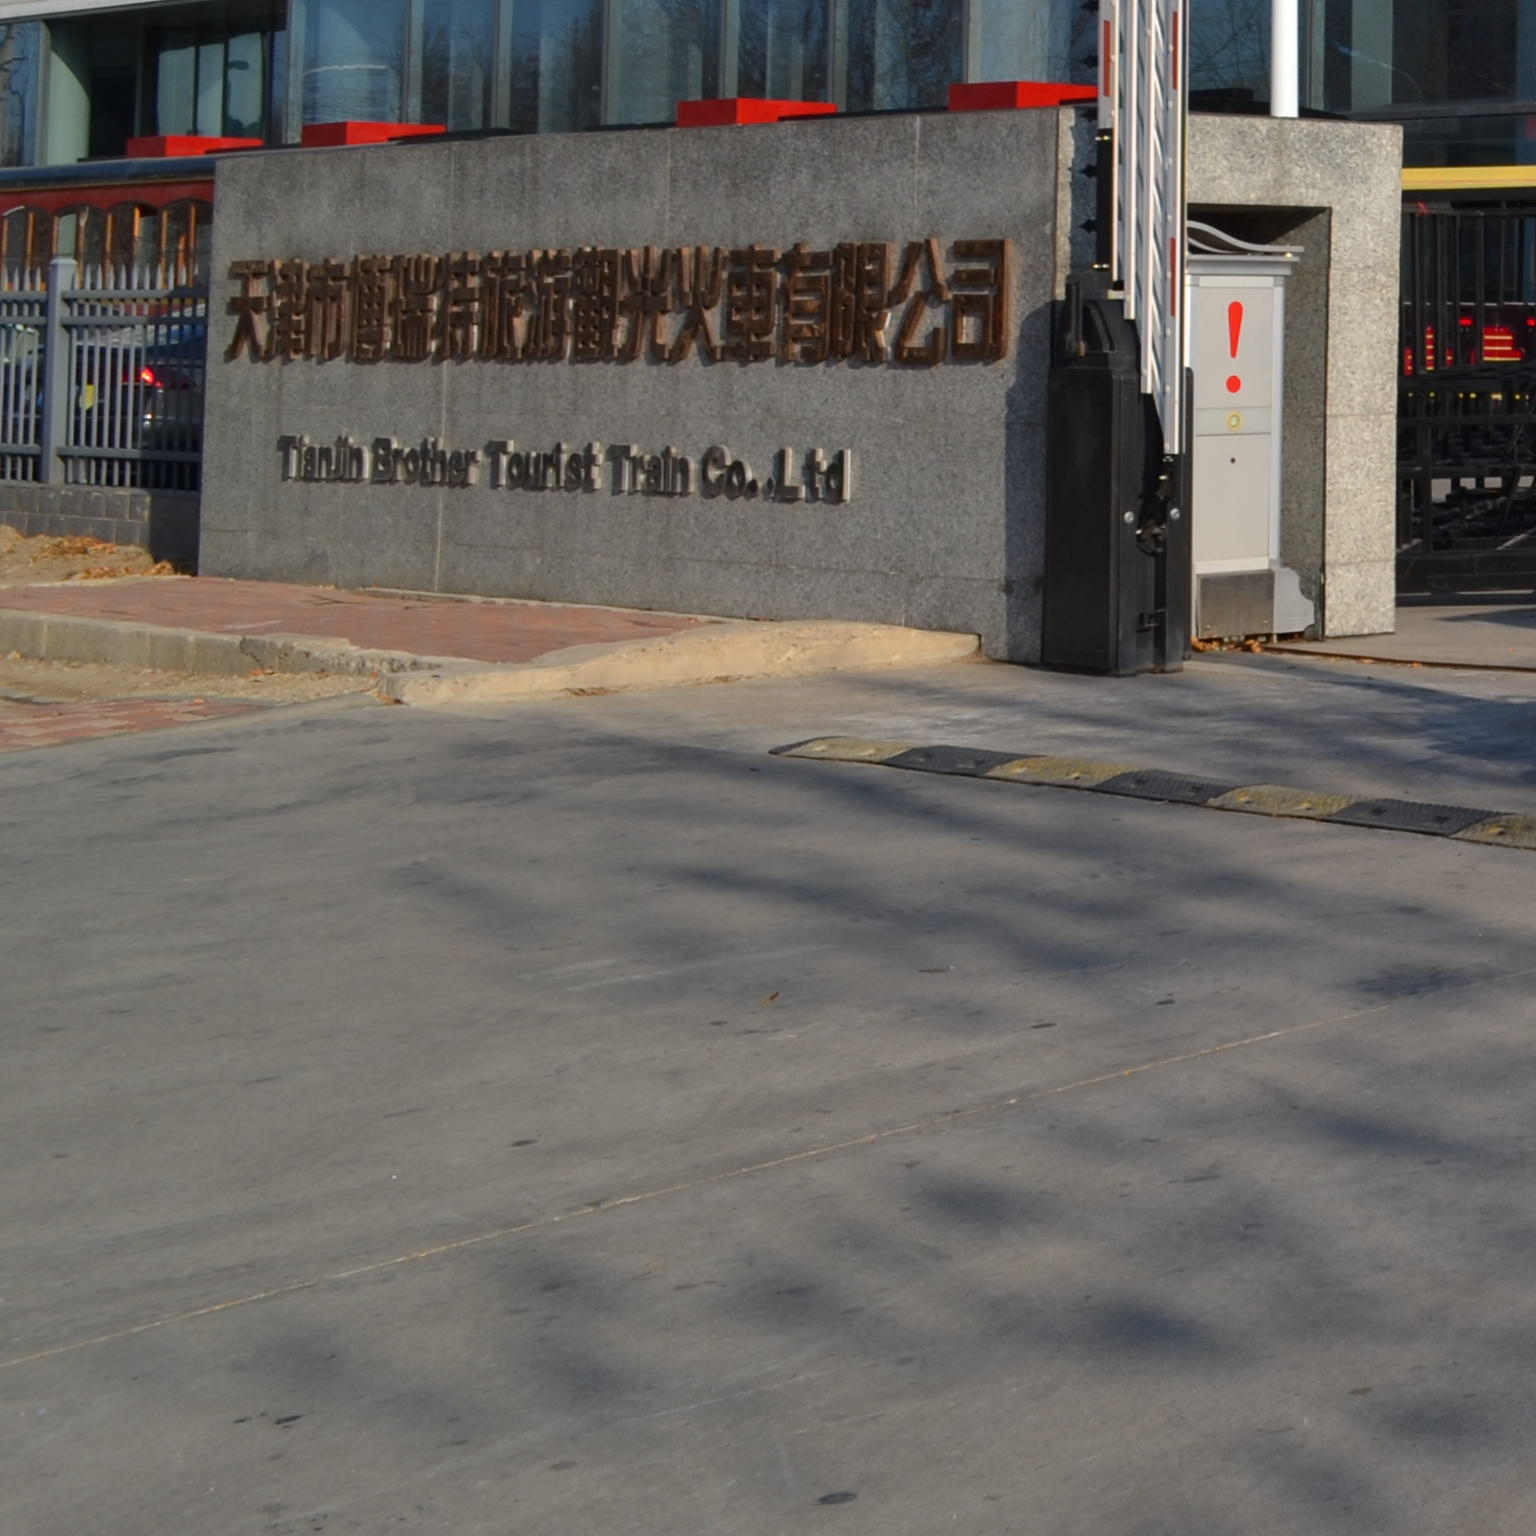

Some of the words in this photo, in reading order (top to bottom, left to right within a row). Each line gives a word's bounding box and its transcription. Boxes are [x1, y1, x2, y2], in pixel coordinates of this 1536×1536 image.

[277, 435, 369, 482] Tianjin
[370, 436, 481, 487] Brother
[487, 440, 603, 491] Tourist
[606, 444, 697, 496] Train
